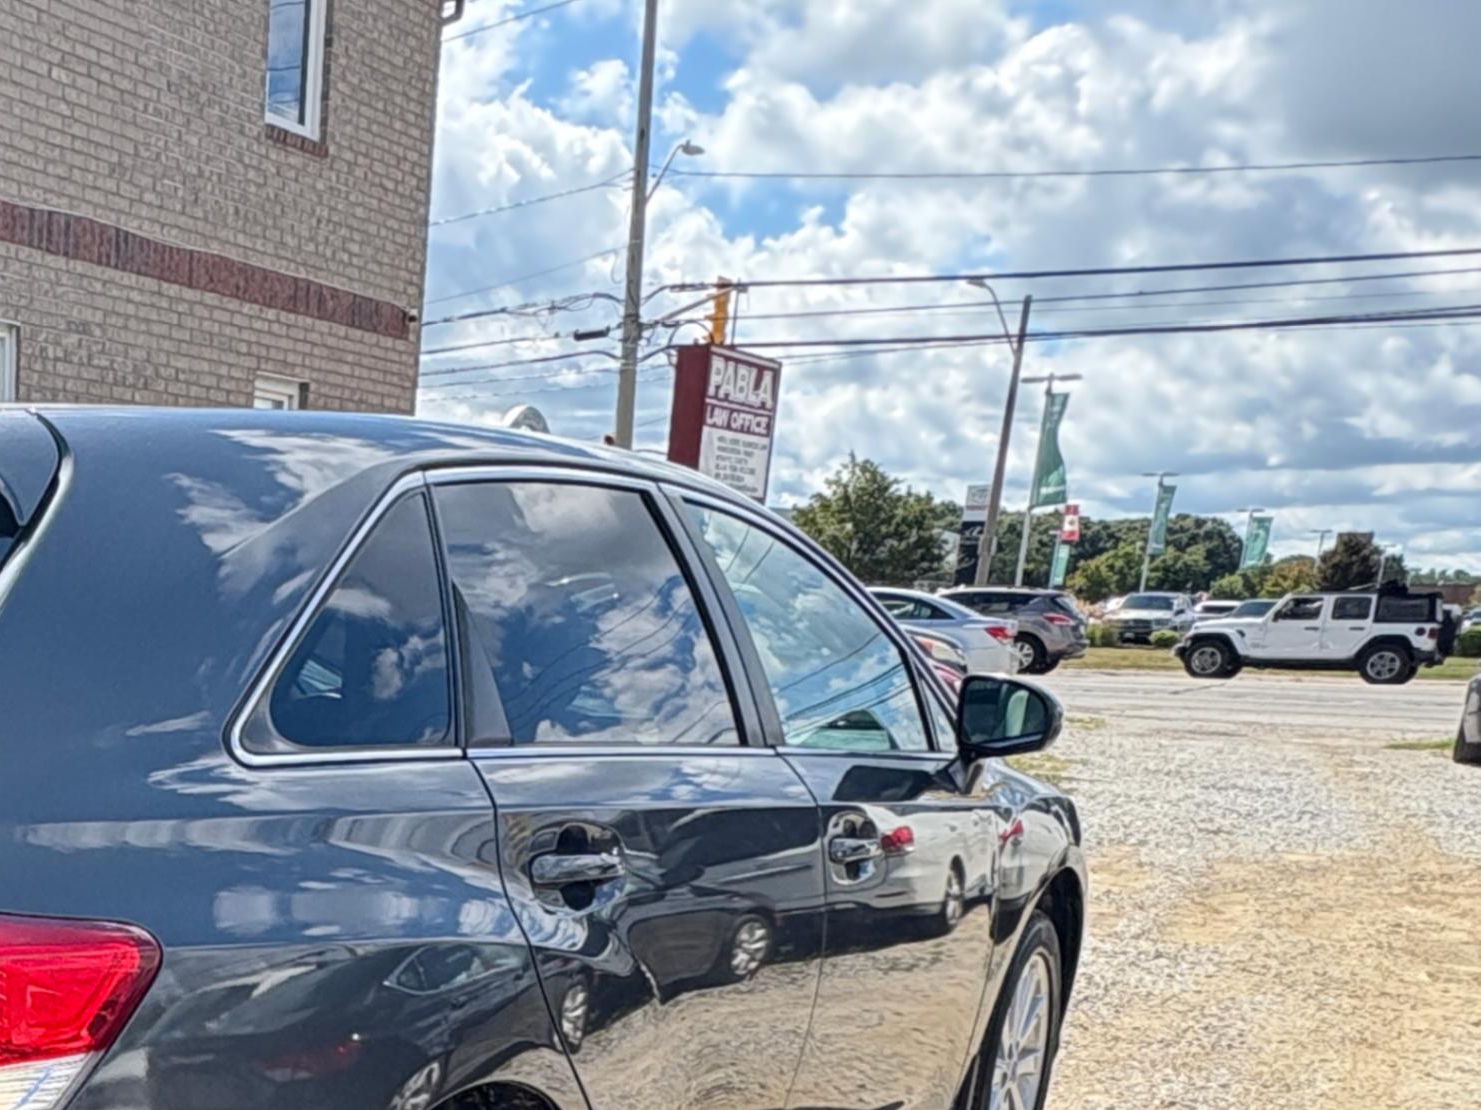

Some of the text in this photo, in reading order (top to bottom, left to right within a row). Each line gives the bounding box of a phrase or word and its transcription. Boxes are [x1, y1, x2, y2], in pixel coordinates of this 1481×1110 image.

[708, 354, 775, 409] PABLA
[706, 405, 769, 434] LAW OFFICE
